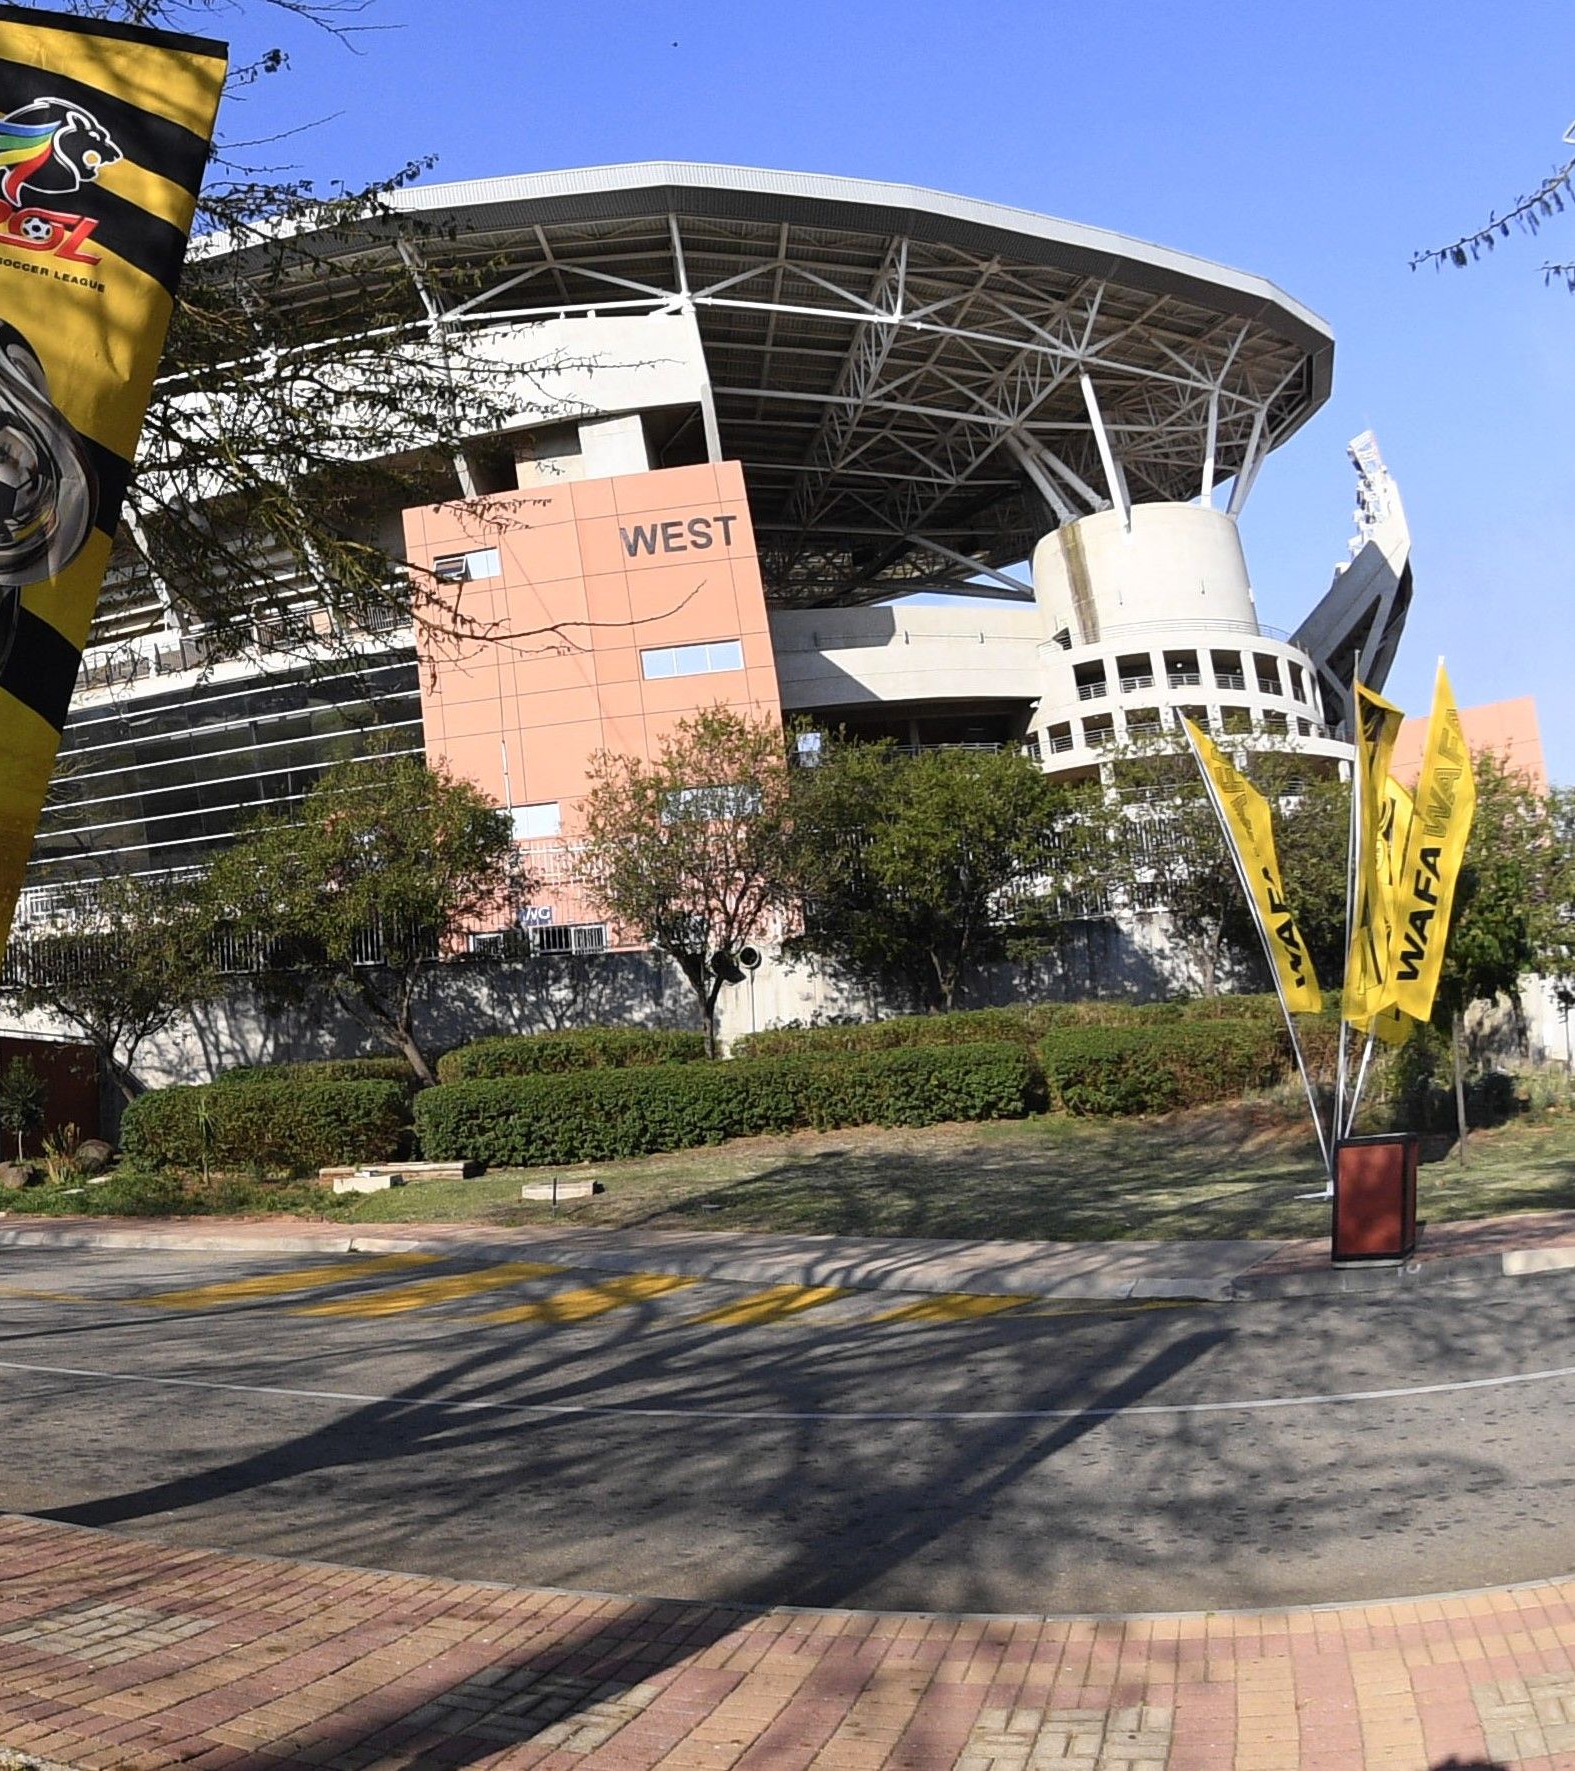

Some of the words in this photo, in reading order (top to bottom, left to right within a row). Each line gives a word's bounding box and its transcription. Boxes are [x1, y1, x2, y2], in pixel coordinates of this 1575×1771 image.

[54, 270, 106, 293] LEAGUE
[619, 515, 737, 557] WEST
[1396, 848, 1441, 980] WAFA
